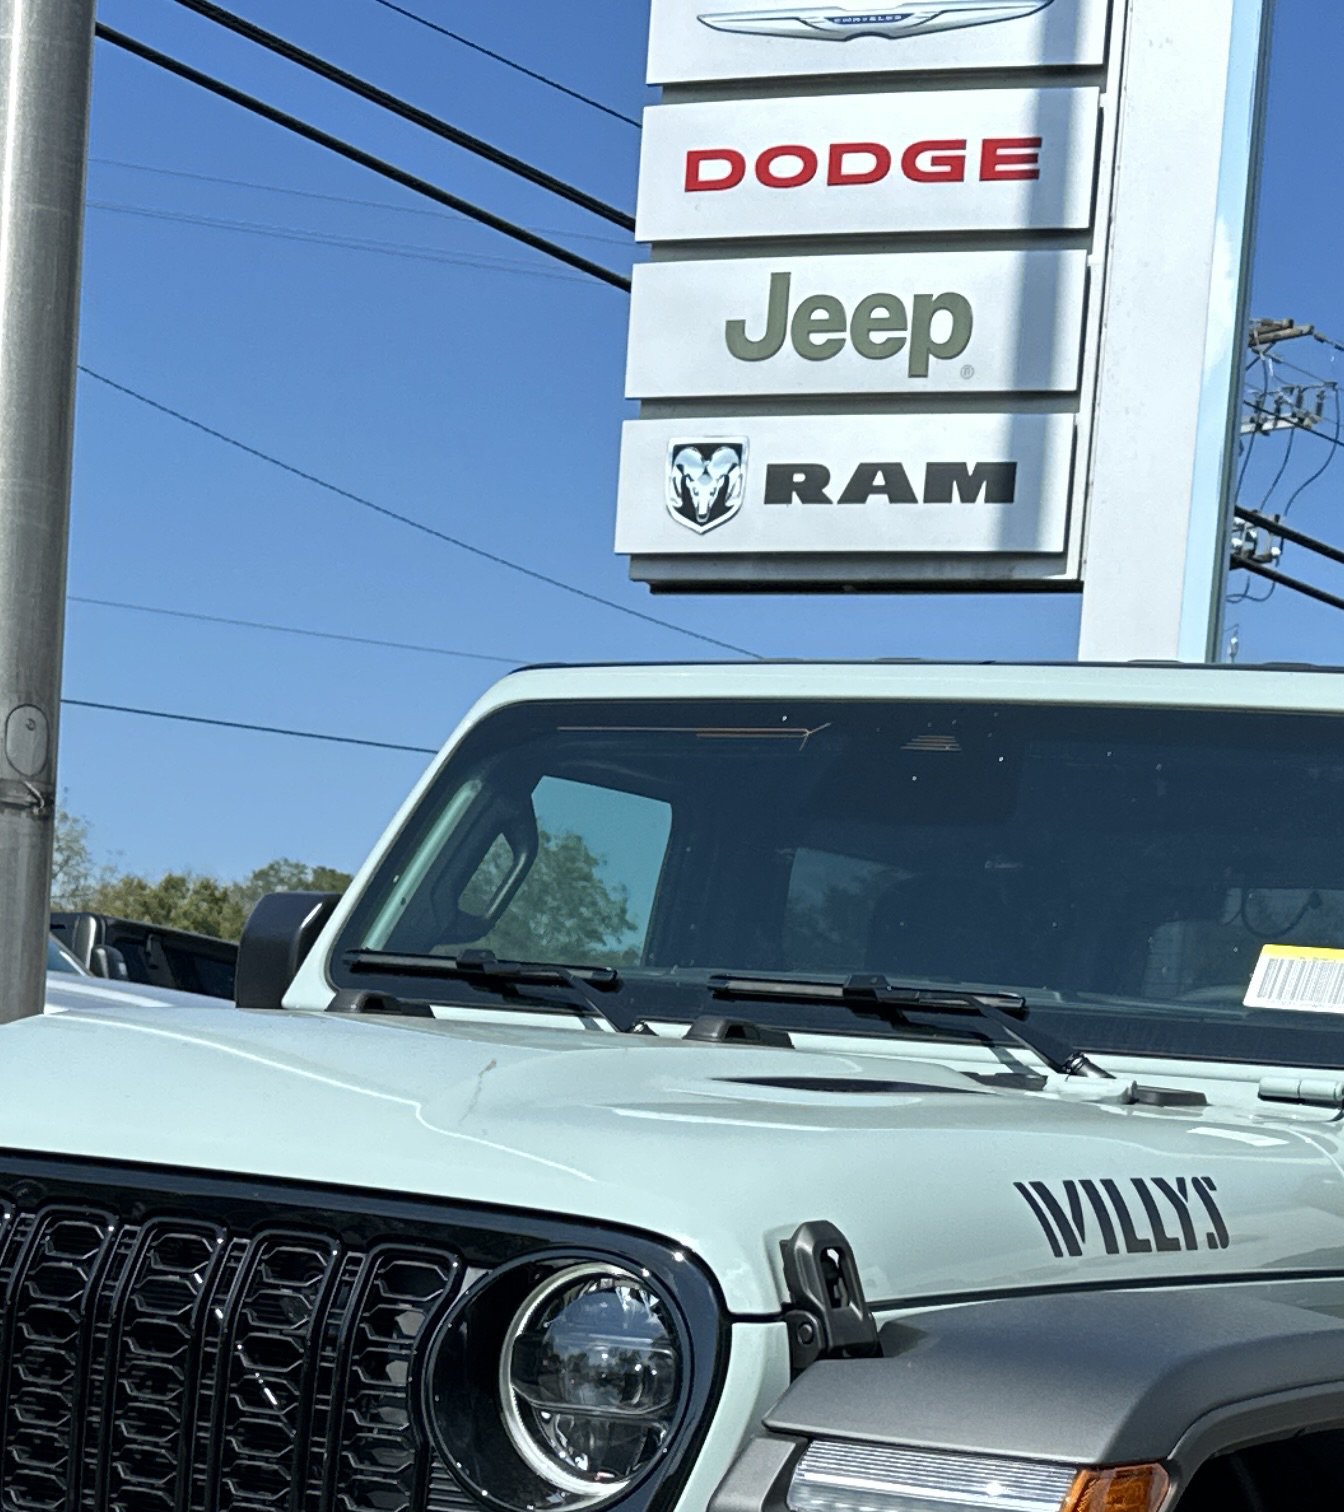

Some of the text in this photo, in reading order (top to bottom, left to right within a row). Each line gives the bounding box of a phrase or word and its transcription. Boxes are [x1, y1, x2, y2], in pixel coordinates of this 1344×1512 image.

[684, 137, 1043, 192] DODGE
[725, 271, 973, 379] Jeep
[763, 461, 1018, 505] RAM
[1013, 1176, 1230, 1258] WILLYS
